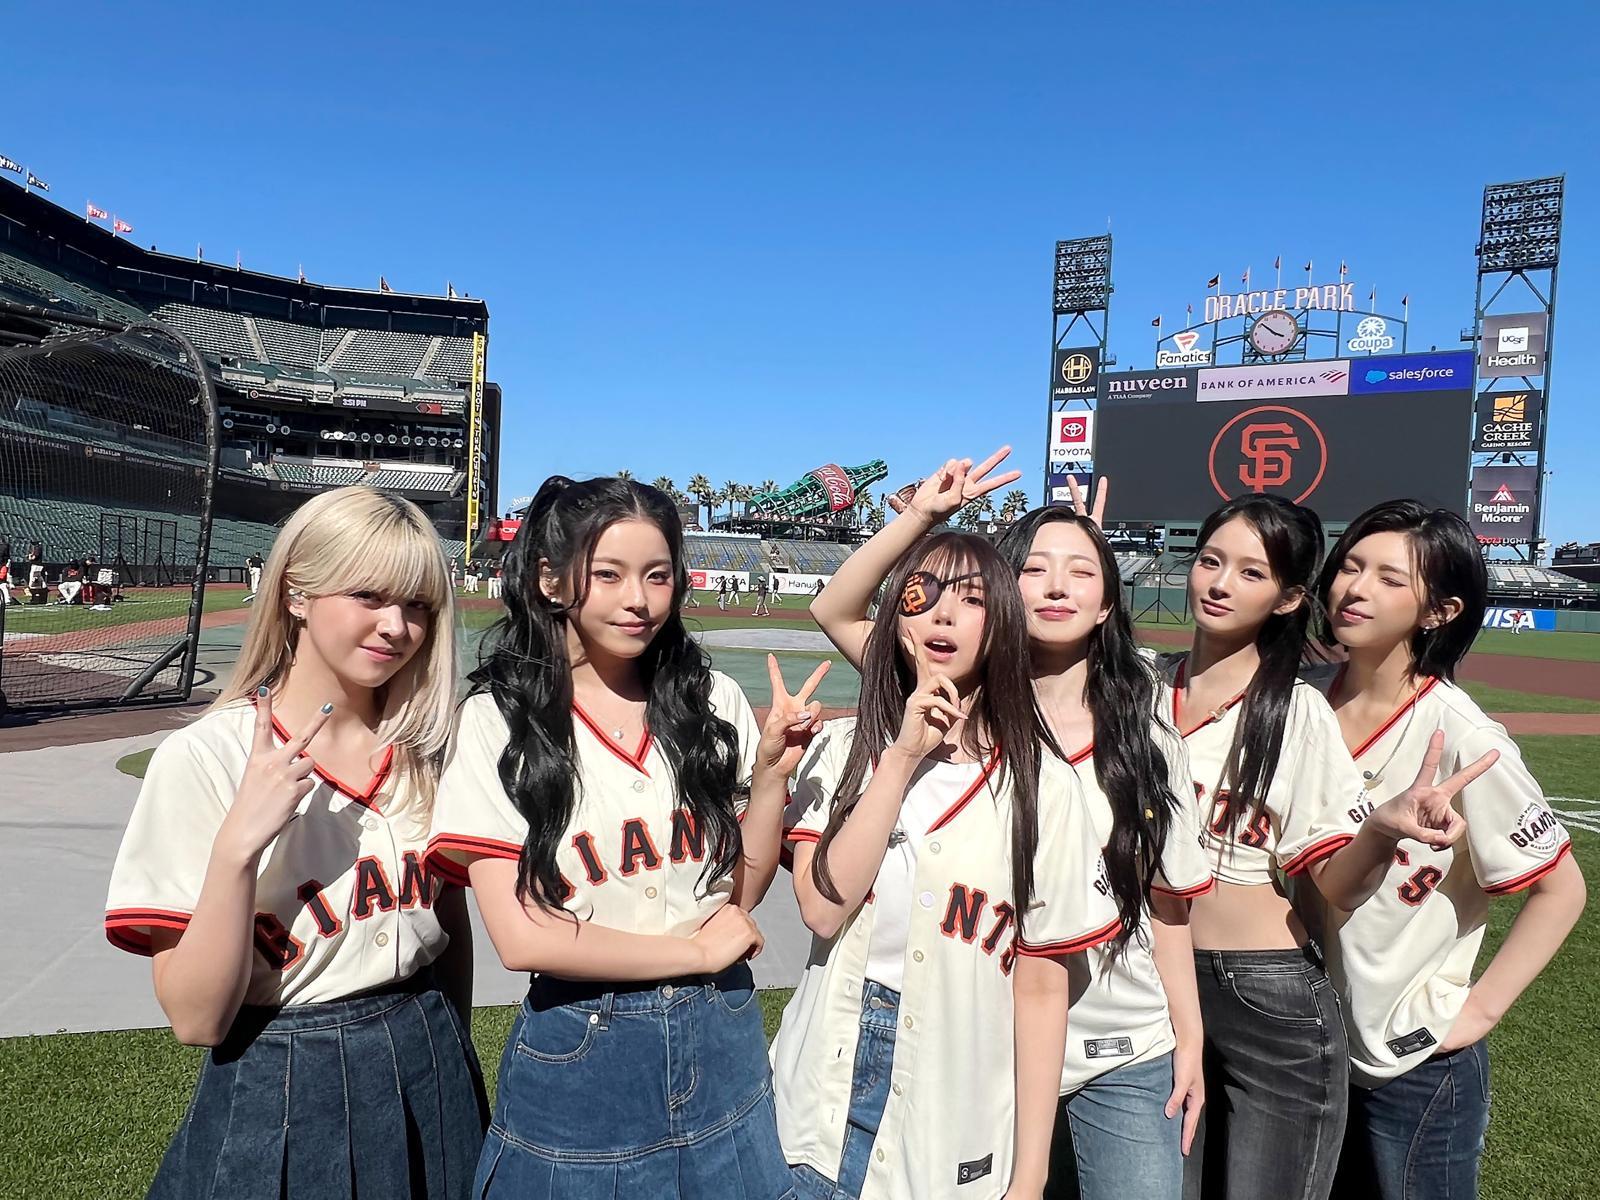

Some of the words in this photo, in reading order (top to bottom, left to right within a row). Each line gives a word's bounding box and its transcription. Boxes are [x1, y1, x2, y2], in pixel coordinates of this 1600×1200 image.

[1204, 289, 1288, 323] ORACLE
[1294, 282, 1355, 312] PARK
[1350, 336, 1391, 350] coupa
[1159, 351, 1212, 364] Fanatics
[1487, 354, 1537, 367] Health
[1388, 367, 1454, 382] salesforce
[1081, 385, 1096, 393] LAW
[1108, 376, 1188, 393] nuveen
[1201, 381, 1234, 390] BANK
[1238, 379, 1253, 388] OF
[1257, 376, 1316, 387] AMERICA
[1482, 422, 1533, 433] CACHE
[1483, 432, 1531, 442] CREEK
[1053, 448, 1092, 457] TOYOTA
[1474, 503, 1530, 515] Benjamin
[1481, 514, 1521, 523] Moore
[253, 849, 435, 972] GIAN
